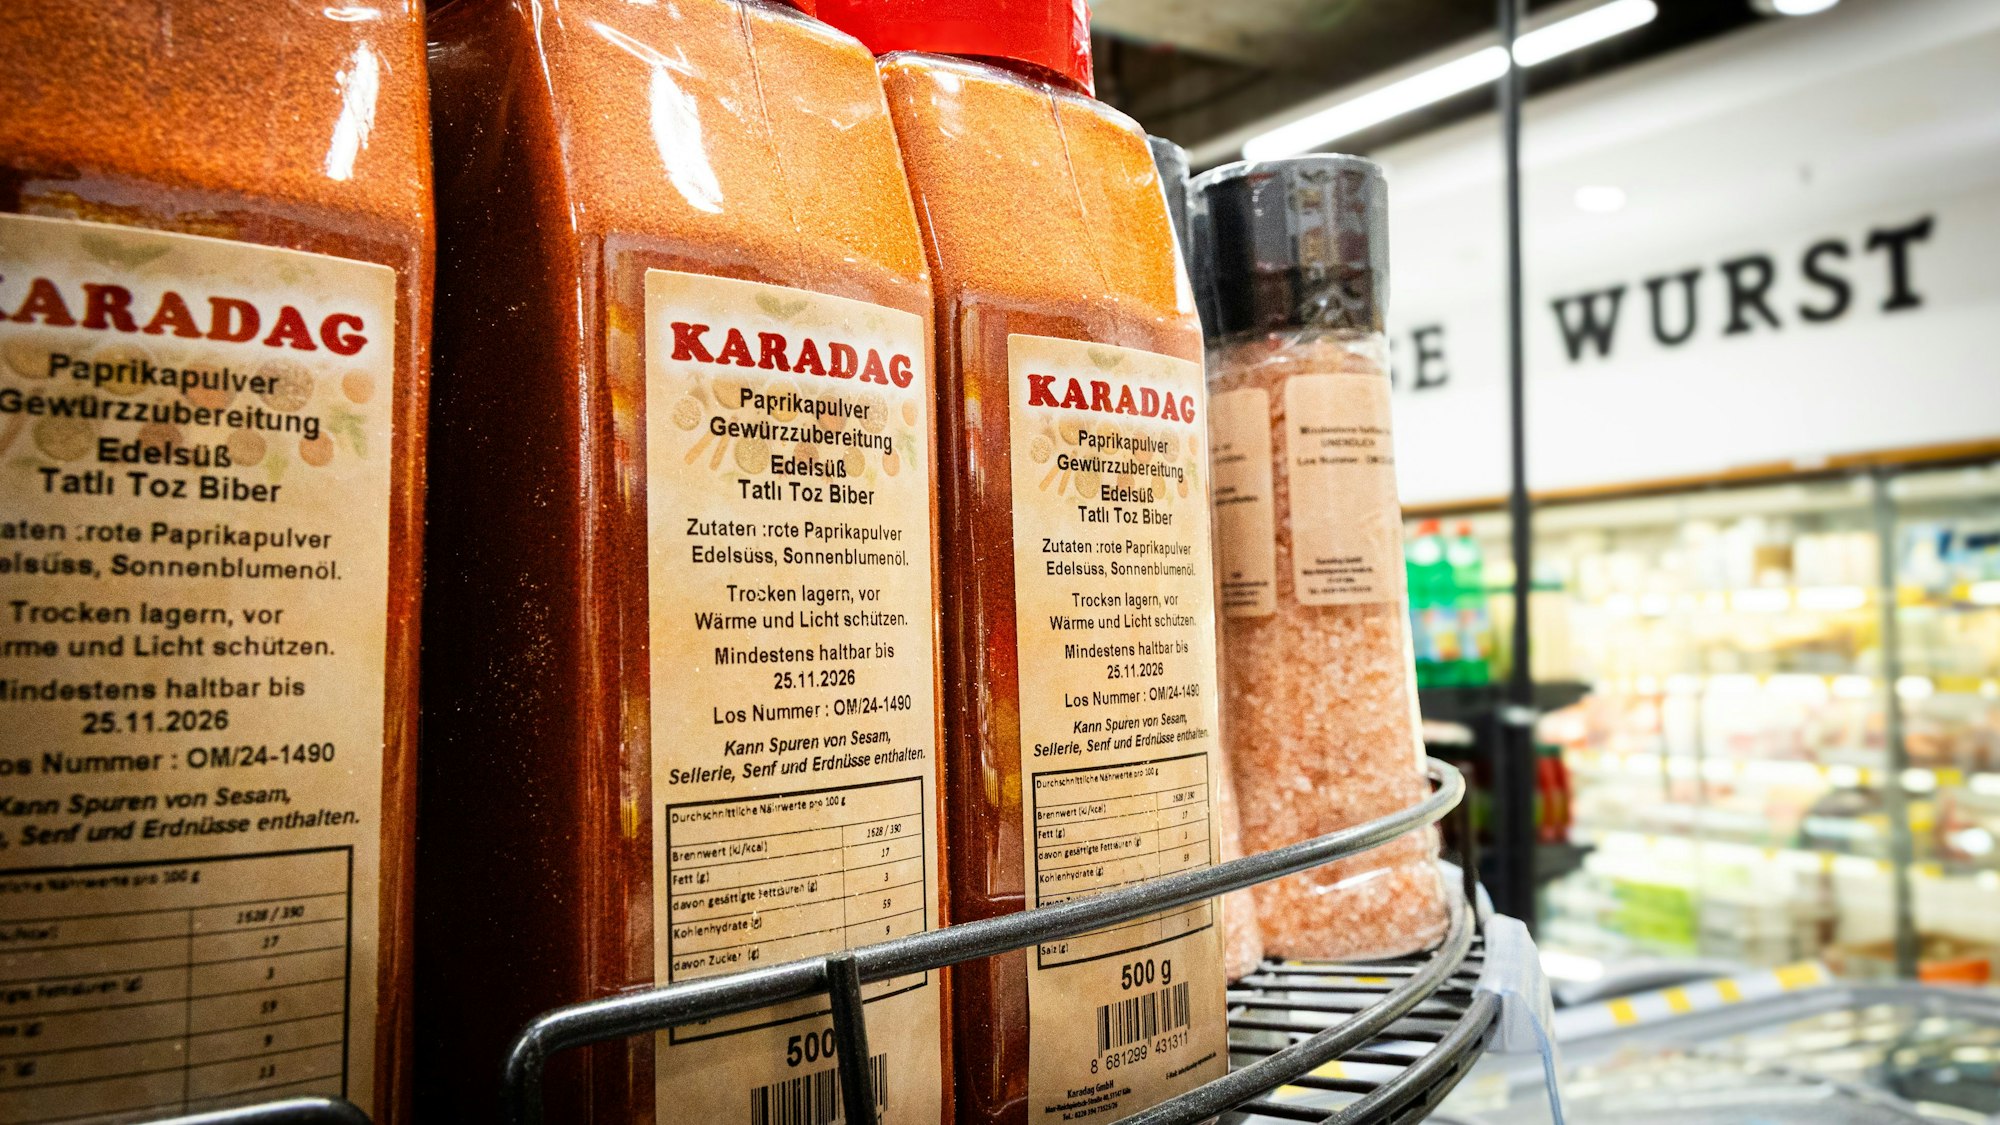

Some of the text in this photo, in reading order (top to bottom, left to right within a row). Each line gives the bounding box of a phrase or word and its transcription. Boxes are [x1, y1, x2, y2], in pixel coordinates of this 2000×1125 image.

[1550, 213, 1937, 363] WURST
[0, 275, 368, 356] ARADAG
[670, 322, 913, 388] KARADAG
[47, 352, 281, 396] Paprikapulver
[740, 387, 870, 420] Paprikapulver
[1027, 374, 1195, 424] KARADAG
[0, 387, 320, 441] Gewürzzubereitung
[710, 416, 892, 456] Gewürzzubereitung
[1078, 429, 1168, 455] Paprikapulver
[97, 437, 232, 468] Edelsüß
[771, 454, 847, 478] Edelsüß
[1057, 454, 1183, 483] Gewürzzubereitung
[37, 466, 281, 503] Tatlı Toz Biber
[738, 479, 874, 505] Tatlı Toz Biber
[1101, 484, 1154, 503] Edelsüß
[1078, 505, 1172, 525] Tatlı Toz Biber
[150, 521, 331, 552] Paprikapulver
[687, 518, 756, 536] Zutaten
[805, 521, 902, 544] Paprikapulver
[692, 545, 908, 567] Edelsüss, Sonnenblumenöl.
[1042, 538, 1092, 553] Zutaten
[1126, 539, 1191, 558] Paprikapulver
[110, 553, 341, 580] Sonnenblumenöl.
[1046, 561, 1196, 577] Edelsüss, Sonnenblumenöl.
[726, 584, 880, 606] Trocken lagern, vor
[1072, 592, 1178, 610] Trocken lagern, vor
[9, 600, 284, 630] Trocken lagern, vor
[694, 610, 908, 630] Wärme und Licht schützen.
[1049, 613, 1196, 630] Wärme und Licht schützen.
[0, 635, 334, 658] rme und Licht schützen.
[715, 642, 894, 665] Mindestens haltbar bis
[1065, 640, 1188, 659] Mindestens haltbar bis
[774, 669, 855, 690] 25.11.2026
[1107, 662, 1163, 679] 25.11.2026
[0, 676, 305, 702] indestens haltbar bis
[1065, 684, 1199, 708] Los Nummer OM/24-1490
[81, 709, 229, 735] 25.11.2026
[714, 694, 911, 724] Los Nummer OM/24-1490
[1073, 713, 1187, 734] Kann Spuren von Sesam,
[724, 730, 891, 756] Kann Spuren von Sesam,
[1033, 726, 1209, 757] Sellerie, Senf und Erdnüsse enthalten.
[41, 752, 163, 774] Nummer
[186, 742, 335, 769] OM/24-1490
[669, 747, 925, 785] Sellerie, Senf und Erdnüsse enthalten.
[67, 793, 158, 819] Spuren
[165, 793, 208, 809] von
[214, 787, 291, 807] Sesam,
[19, 823, 82, 847] Senf
[86, 820, 136, 843] und
[141, 816, 251, 840] Erdnüsse
[257, 809, 360, 832] enthalten.
[672, 847, 726, 862] Brennwert
[881, 847, 890, 858] 17
[673, 874, 693, 885] Fett
[884, 872, 889, 882] 3
[672, 899, 704, 910] davon
[673, 921, 748, 939] Kohlenhydrate
[673, 956, 705, 970] davon
[709, 952, 741, 966] Zucker
[1121, 959, 1171, 990] 500 g
[786, 1032, 836, 1067] 500
[1090, 1059, 1098, 1074] 8
[1106, 1045, 1147, 1070] 681299
[1155, 1030, 1189, 1054] 431311
[1067, 1079, 1114, 1099] Karadag GmbH
